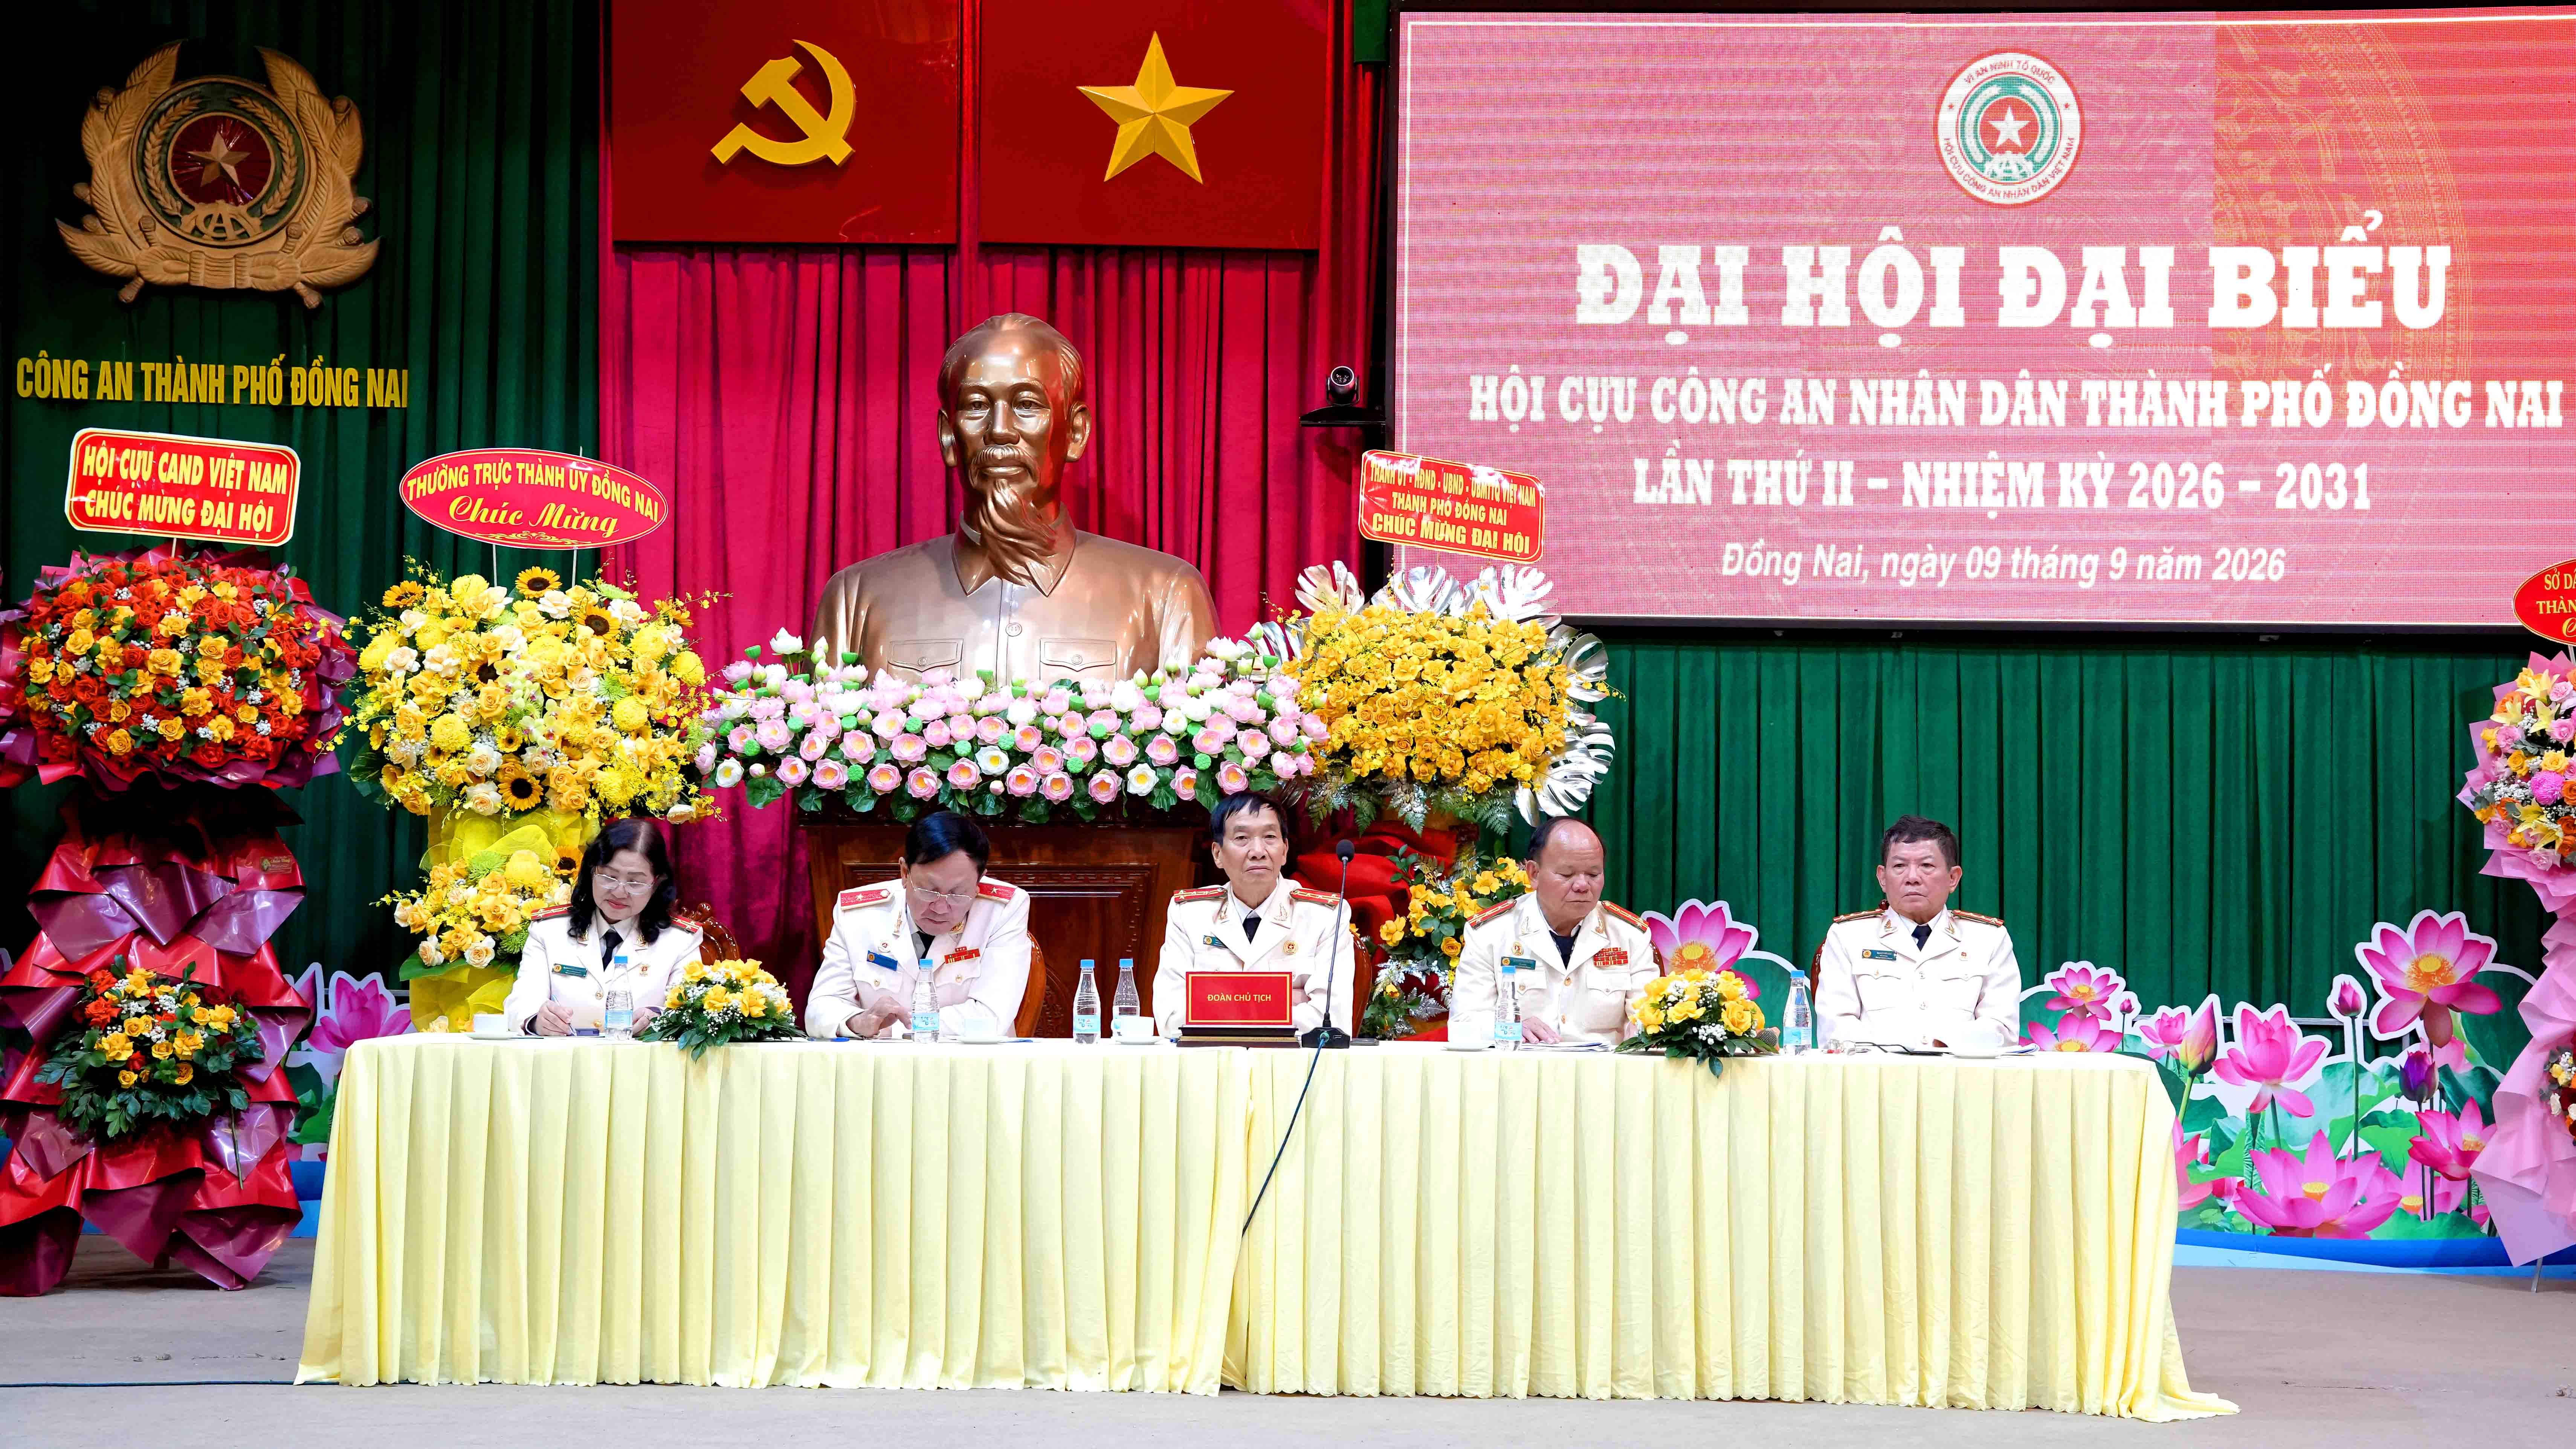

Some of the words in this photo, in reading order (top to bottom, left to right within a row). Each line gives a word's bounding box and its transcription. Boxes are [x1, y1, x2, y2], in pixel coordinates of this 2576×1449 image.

[1975, 67, 1988, 78] AN
[1990, 60, 2013, 70] NINH
[1987, 188, 2000, 199] AN
[1576, 244, 1748, 345] ĐẠI
[1782, 226, 1965, 348] HỘI
[1997, 246, 2174, 348] ĐẠI
[2208, 209, 2451, 330] BIỂU
[17, 350, 89, 400] CÔNG
[96, 361, 133, 401] AN
[141, 356, 225, 404] THÀNH
[233, 353, 285, 405] PHỐ
[291, 355, 358, 407] ĐỒNG
[367, 368, 408, 408] NAI
[1469, 364, 1545, 433] HỘI
[1558, 376, 1637, 433] CỰU
[1650, 366, 1767, 425] CÔNG
[1780, 378, 1836, 425] AN
[1849, 368, 1966, 426] NHÂN
[1980, 370, 2067, 427] DÂN
[2081, 370, 2226, 427] THÀNH
[2242, 363, 2333, 428] PHỐ
[2346, 362, 2471, 429] ĐỒNG
[2485, 380, 2563, 428] NAI
[82, 441, 115, 485] HỘI
[120, 449, 153, 488] CỰU
[158, 452, 203, 486] CAND
[209, 453, 246, 497] VIỆT
[248, 460, 287, 494] NAM
[407, 465, 469, 501] THƯỜNG
[473, 458, 512, 490] TRỰC
[516, 458, 564, 488] THÀNH
[591, 469, 631, 508] ĐỒNG
[635, 491, 658, 522] NAI
[1443, 472, 1464, 495] UBND
[1518, 485, 1536, 507] NAM
[1634, 440, 1713, 504] LẦN
[1727, 449, 1811, 505] THỨ
[1823, 460, 1854, 506] II
[1903, 450, 2043, 519] NHIỆM
[2058, 451, 2114, 507] KỲ
[2127, 462, 2225, 509] 2026
[2275, 462, 2370, 511] 2031
[85, 489, 133, 521] CHÚC
[138, 495, 195, 526] MỪNG
[200, 500, 232, 535] ĐẠI
[239, 500, 273, 538] HỘI
[449, 495, 523, 525] Chúc
[528, 502, 620, 538] Mừng
[1392, 490, 1427, 513] THÀNH
[1430, 495, 1452, 517] PHỐ
[1455, 498, 1486, 522] ĐỒNG
[1489, 507, 1507, 526] NAI
[1372, 513, 1416, 536] CHÚC
[1420, 518, 1467, 545] MỪNG
[1472, 528, 1498, 552] ĐẠI
[1503, 532, 1530, 556] HỘI
[1722, 538, 1803, 585] Đồng
[1813, 543, 1871, 583] Nai,
[1882, 543, 1956, 587] ngày
[1966, 546, 2001, 579] 09
[2010, 545, 2100, 588] tháng
[2110, 546, 2127, 580] 9
[2136, 549, 2203, 581] năm
[2211, 547, 2286, 582] 2026
[2544, 568, 2560, 590] SỞ
[1208, 992, 1232, 1001] ĐOÀN
[1234, 992, 1251, 1001] CHỦ
[1253, 994, 1271, 1003] TỊCH
